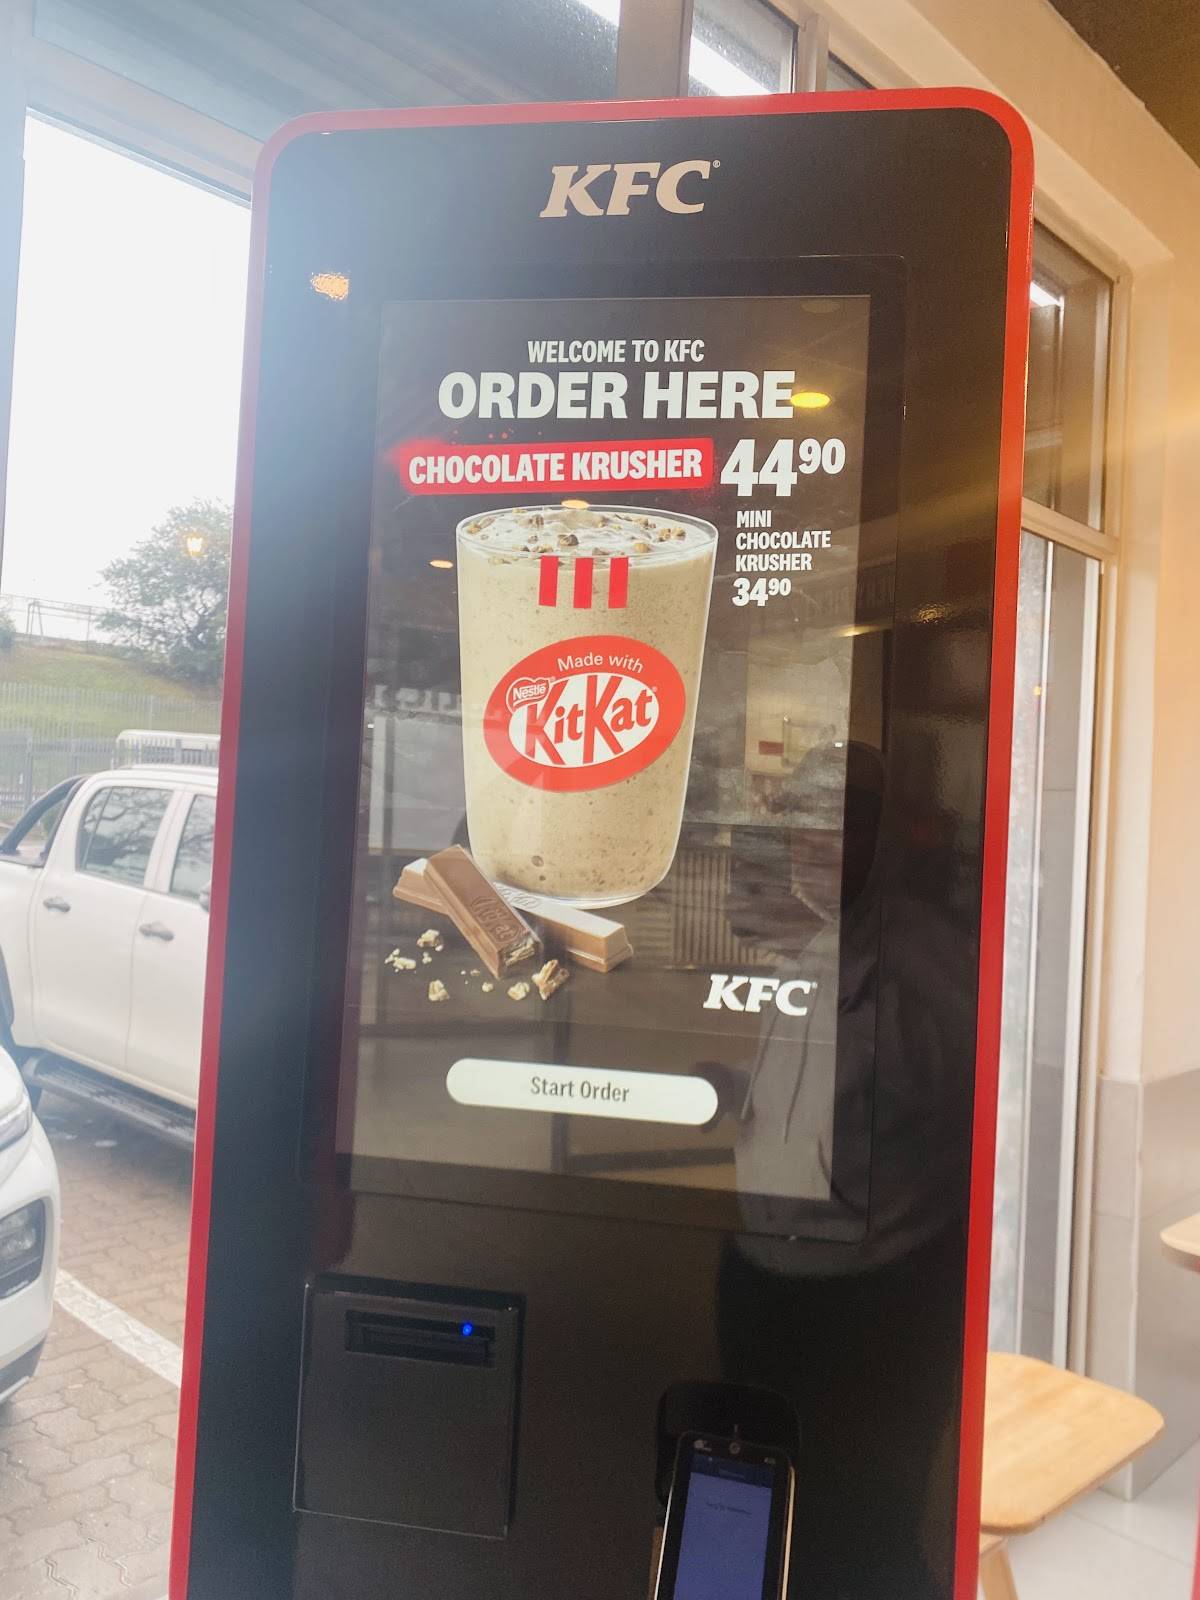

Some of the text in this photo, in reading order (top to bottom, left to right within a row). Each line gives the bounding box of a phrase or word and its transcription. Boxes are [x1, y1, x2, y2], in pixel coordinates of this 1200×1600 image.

[539, 160, 711, 218] KFC
[528, 340, 705, 363] WELCOME TO KFC
[438, 371, 795, 419] ORDER HERE
[408, 448, 703, 484] CHOCOLATE KRUSHER
[736, 510, 772, 528] MINI
[735, 530, 832, 550] CHOCOLATE
[735, 553, 813, 572] KRUSHER
[557, 652, 644, 673] Made with
[524, 674, 654, 766] KitKat
[702, 973, 811, 1016] KFC
[530, 1076, 630, 1102] Start Order
